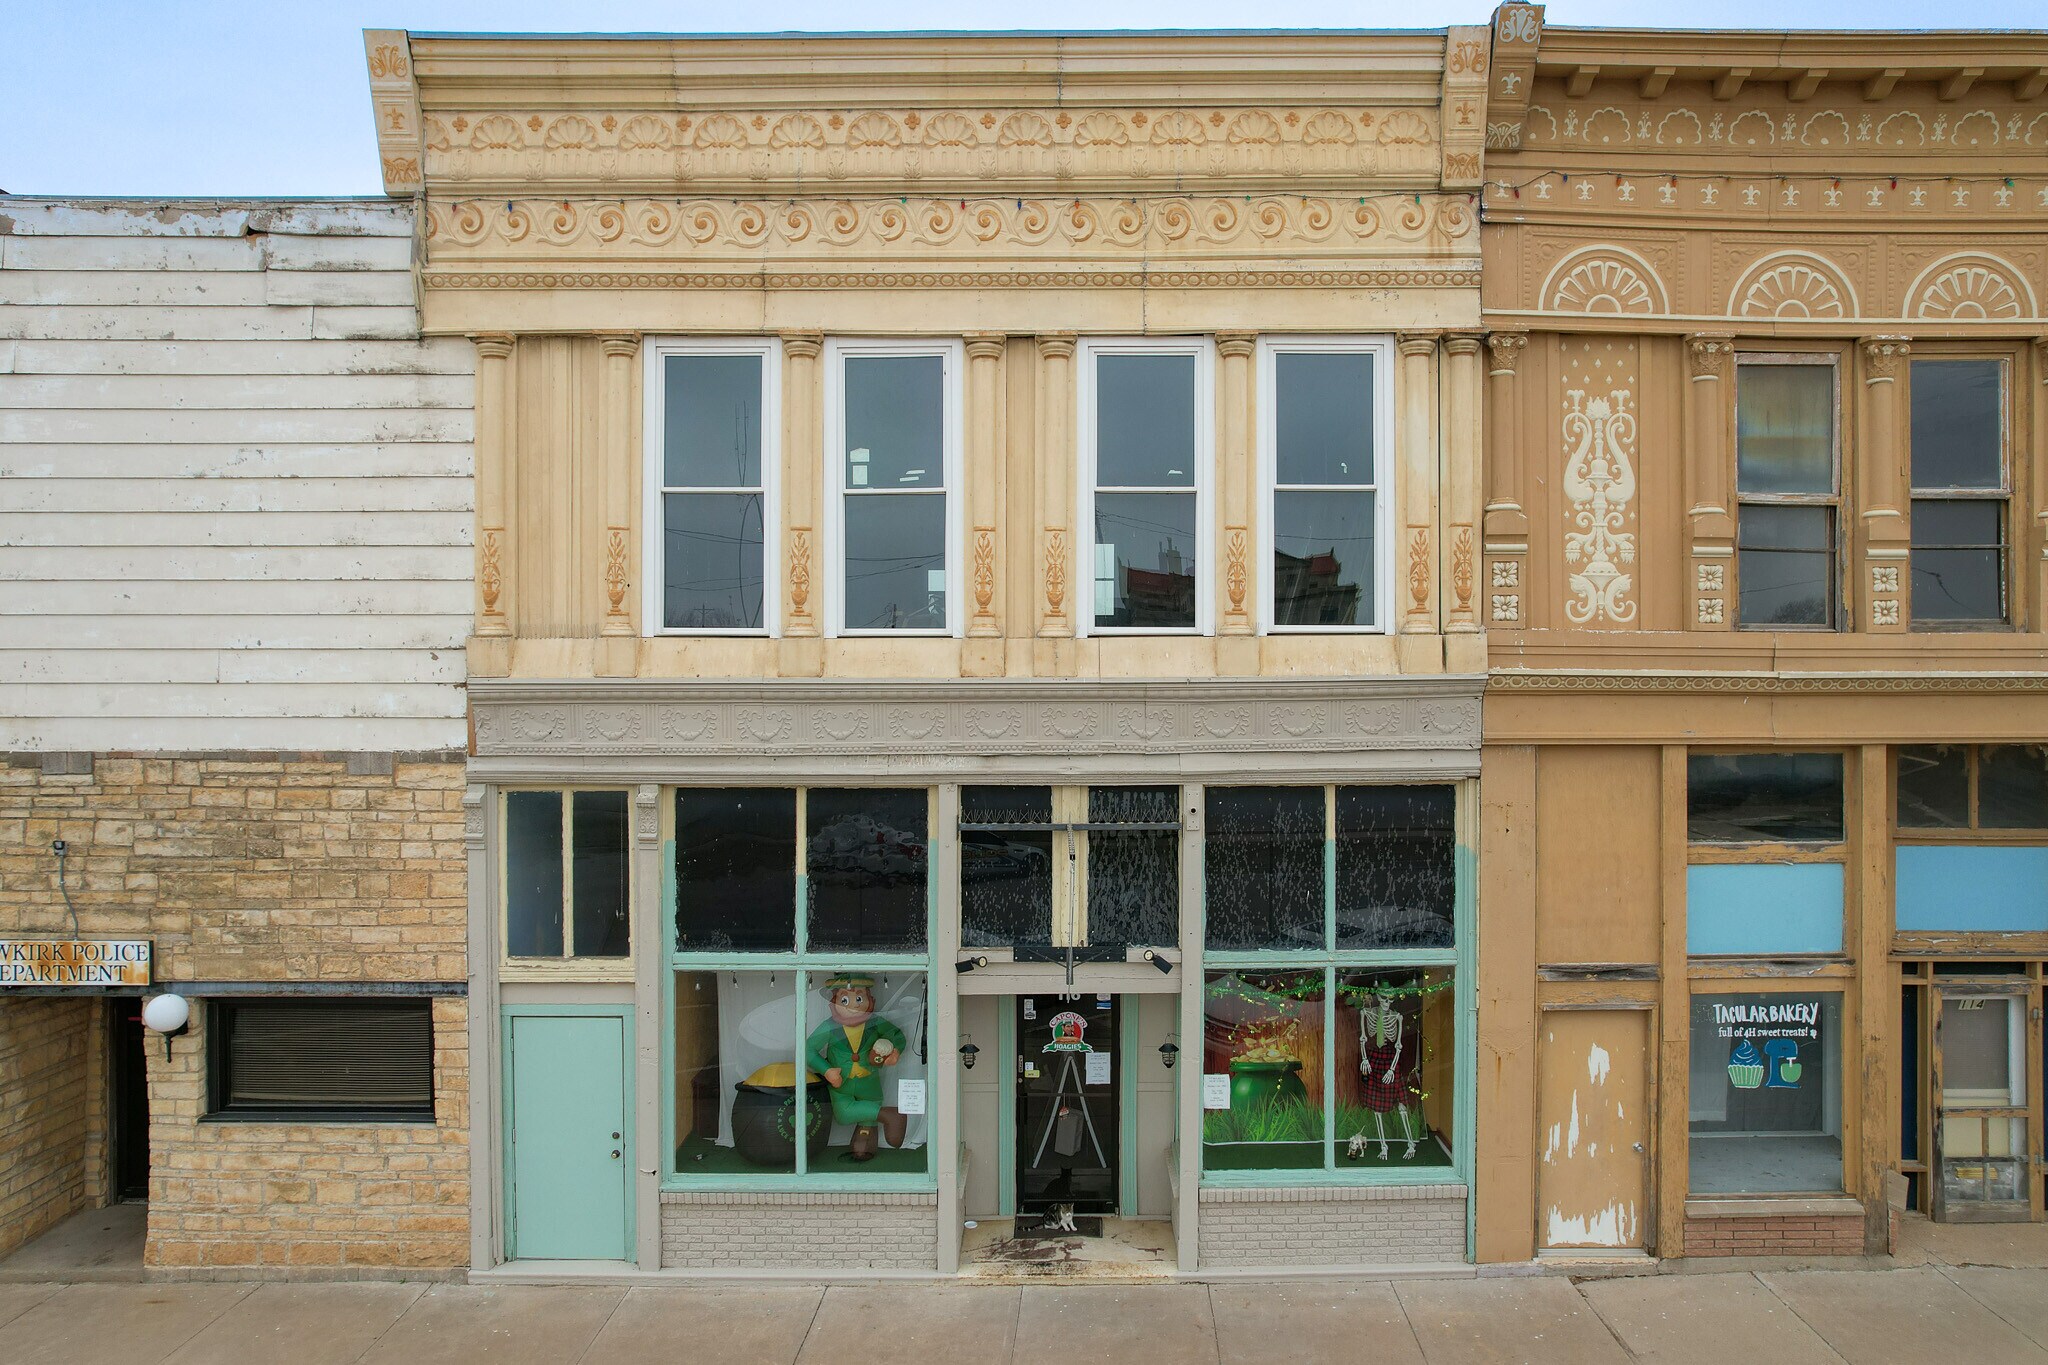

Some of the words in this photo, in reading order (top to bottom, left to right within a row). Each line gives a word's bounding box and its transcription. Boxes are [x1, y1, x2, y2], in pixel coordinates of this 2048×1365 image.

[73, 944, 148, 961] POLICE
[1962, 1000, 1984, 1008] 114
[1051, 1012, 1086, 1027] CAPONE'S
[1769, 1002, 1819, 1026] BAKERY
[1718, 1027, 1733, 1038] full
[1734, 1026, 1743, 1038] of
[1744, 1028, 1756, 1039] 4H
[1757, 1028, 1781, 1038] sweet
[1782, 1027, 1808, 1038] treats!
[777, 1124, 790, 1140] LUCK
